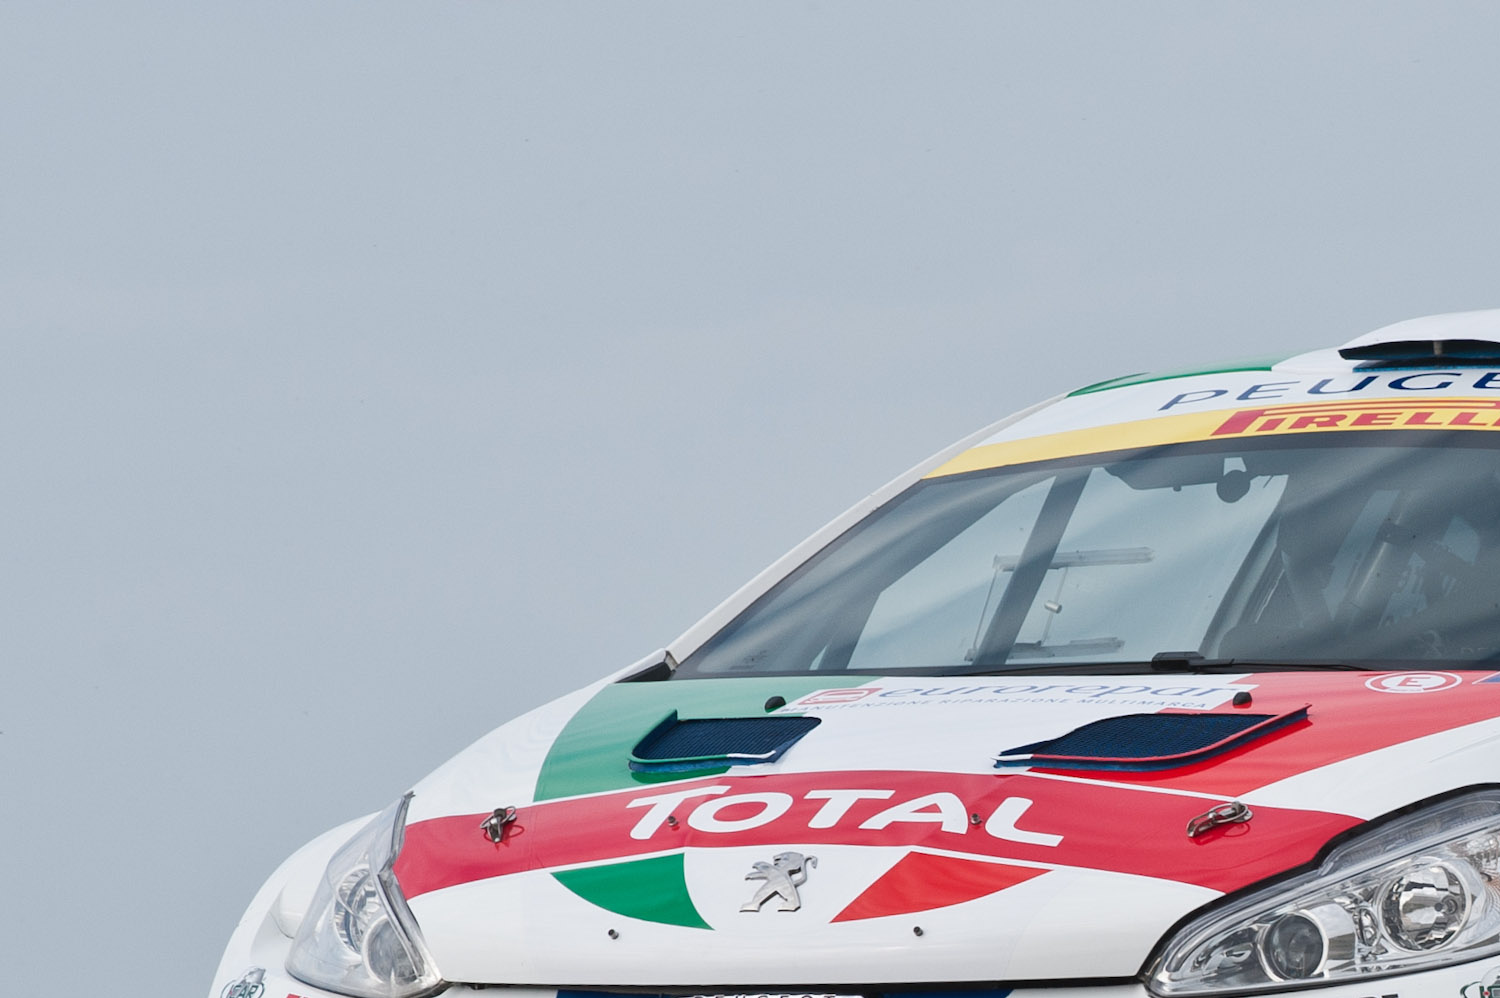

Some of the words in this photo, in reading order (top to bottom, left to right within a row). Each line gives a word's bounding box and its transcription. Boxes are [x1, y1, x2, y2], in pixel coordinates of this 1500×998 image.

[878, 683, 1238, 698] eurorepar
[1076, 699, 1207, 708] MULTIMARCA
[626, 785, 1065, 848] TOTAL
